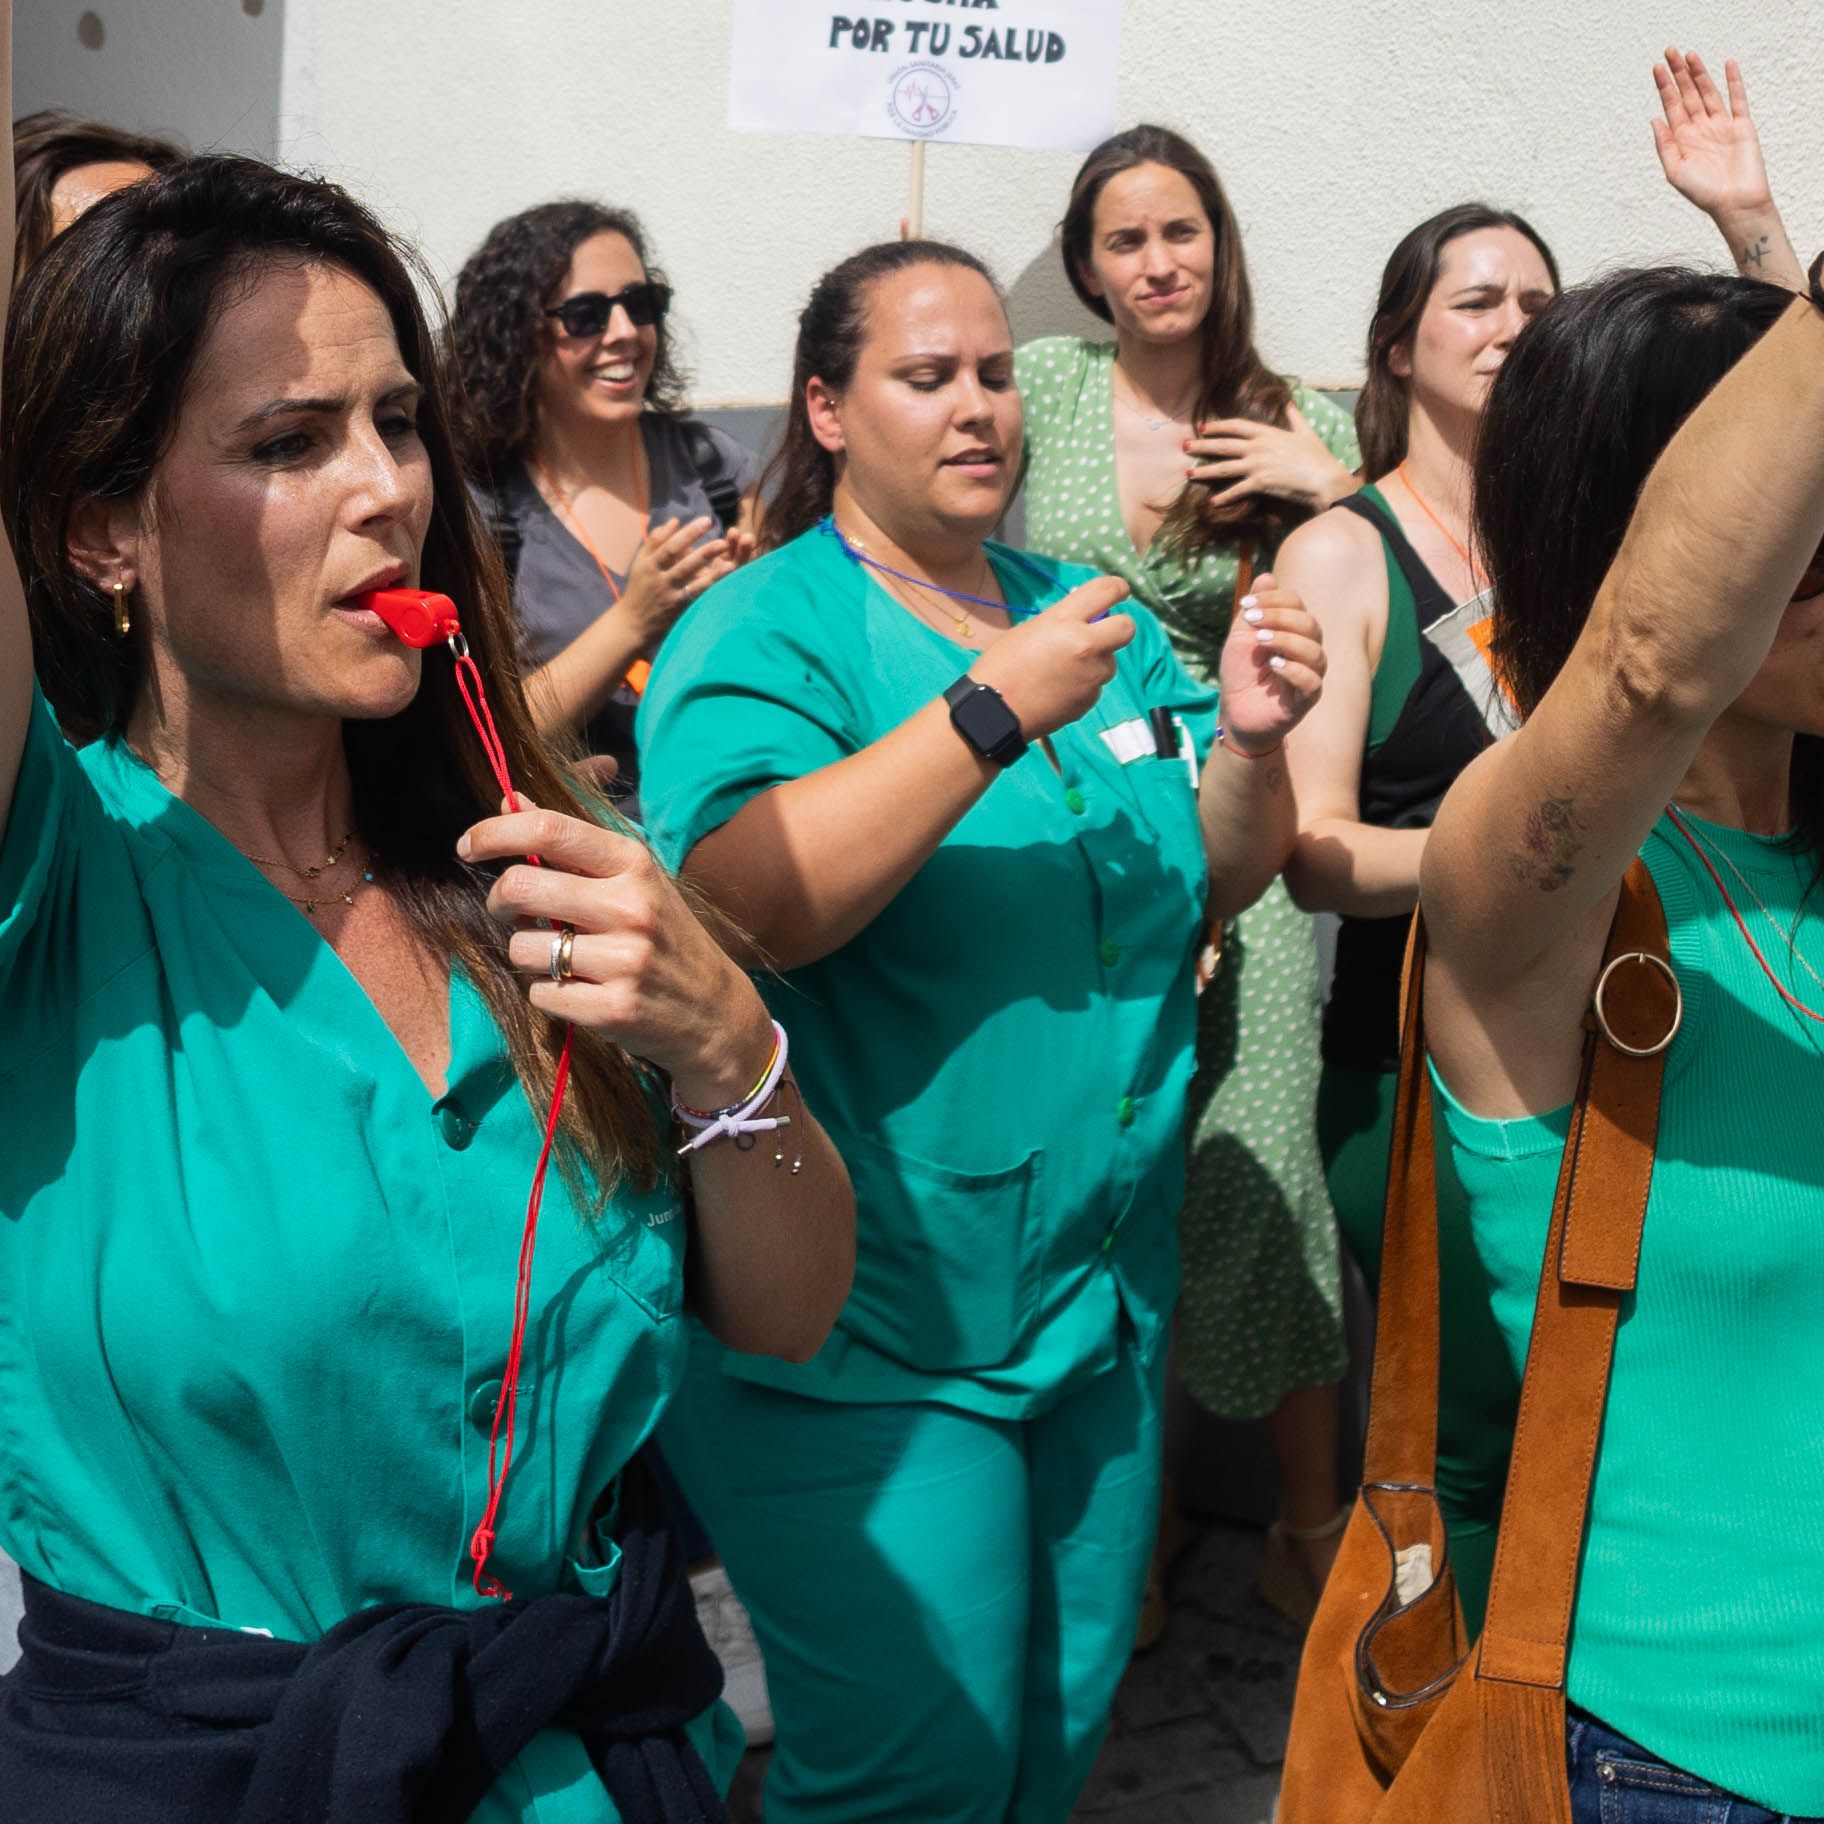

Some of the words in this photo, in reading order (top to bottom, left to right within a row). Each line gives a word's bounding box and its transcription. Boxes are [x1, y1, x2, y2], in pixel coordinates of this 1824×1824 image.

[829, 16, 895, 53] POR
[904, 20, 951, 56] TU
[959, 25, 1067, 64] SALUD
